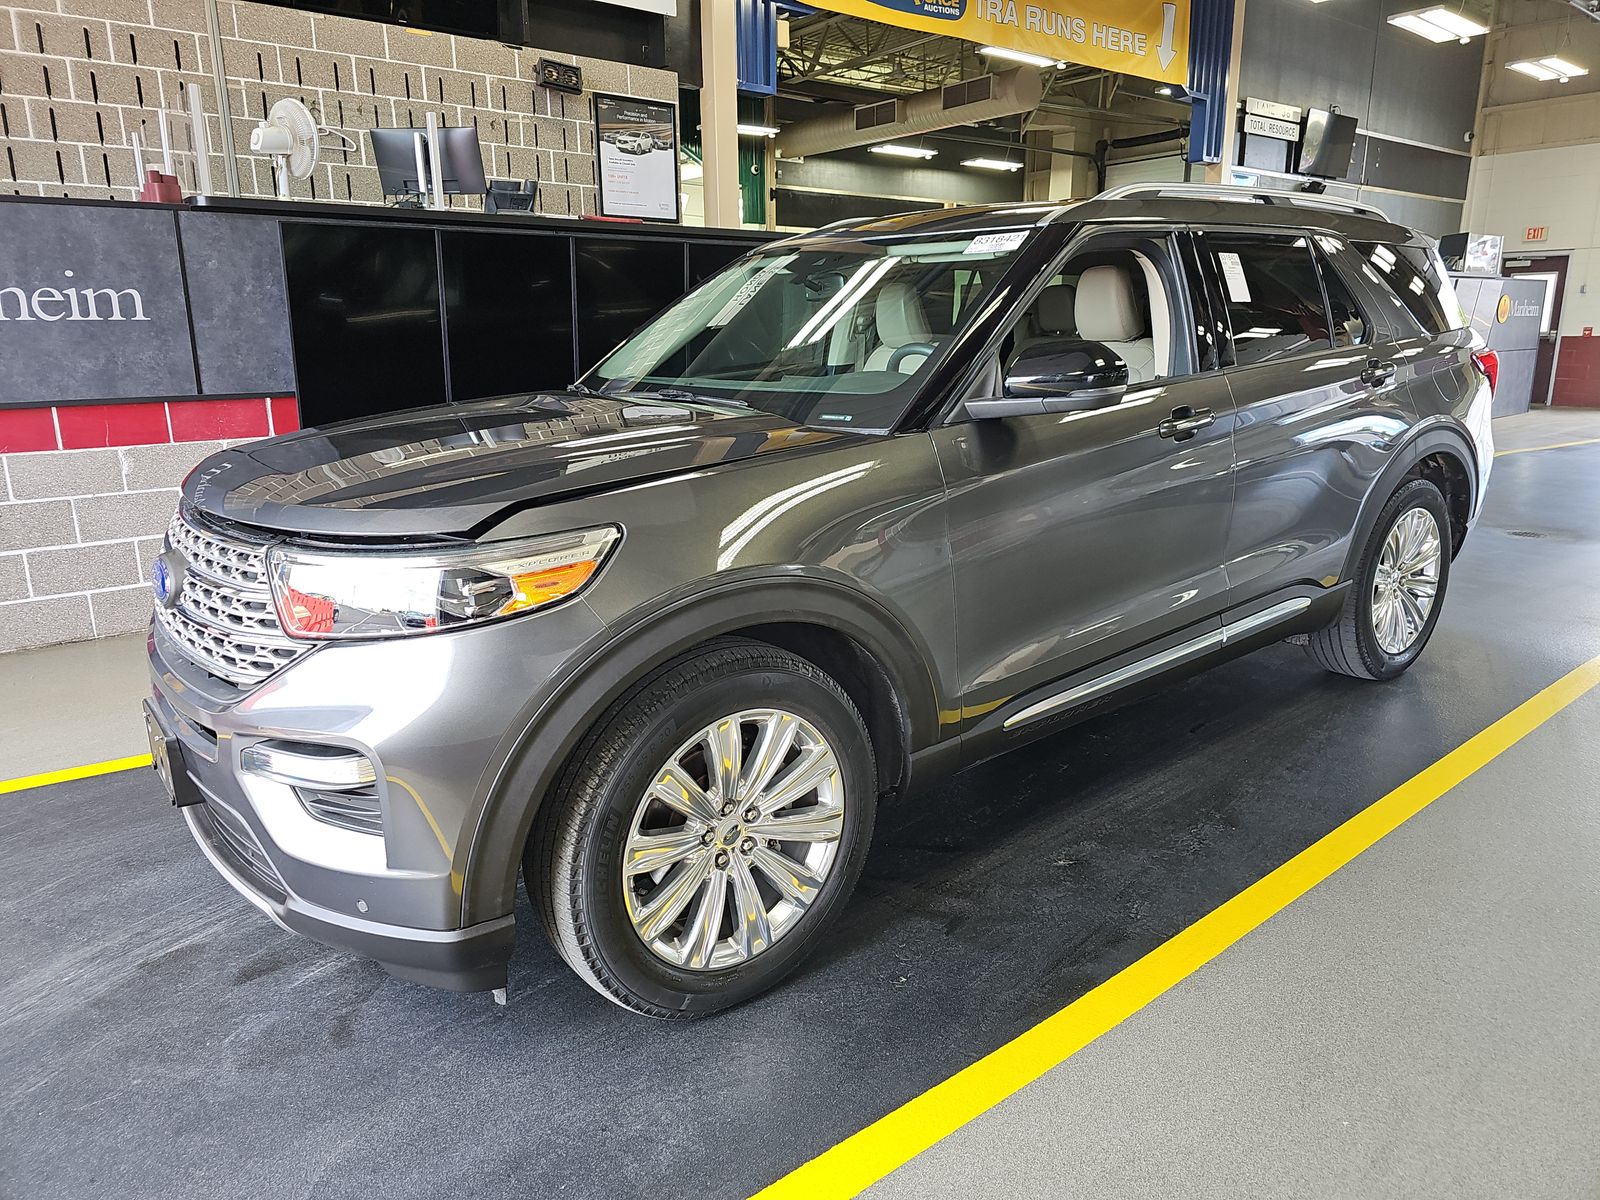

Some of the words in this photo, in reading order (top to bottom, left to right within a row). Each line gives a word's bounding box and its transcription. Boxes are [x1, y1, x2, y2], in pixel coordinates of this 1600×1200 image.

[924, 3, 960, 16] AUCTIONS
[976, 0, 1019, 27] TRA
[1025, 5, 1086, 44] RUNS
[1092, 23, 1147, 57] HERE
[1250, 119, 1267, 132] TOTAL
[1269, 123, 1296, 138] RESOURCE
[1526, 226, 1545, 240] EXIT
[1508, 300, 1540, 317] Manheim
[506, 549, 591, 571] EXPLORER
